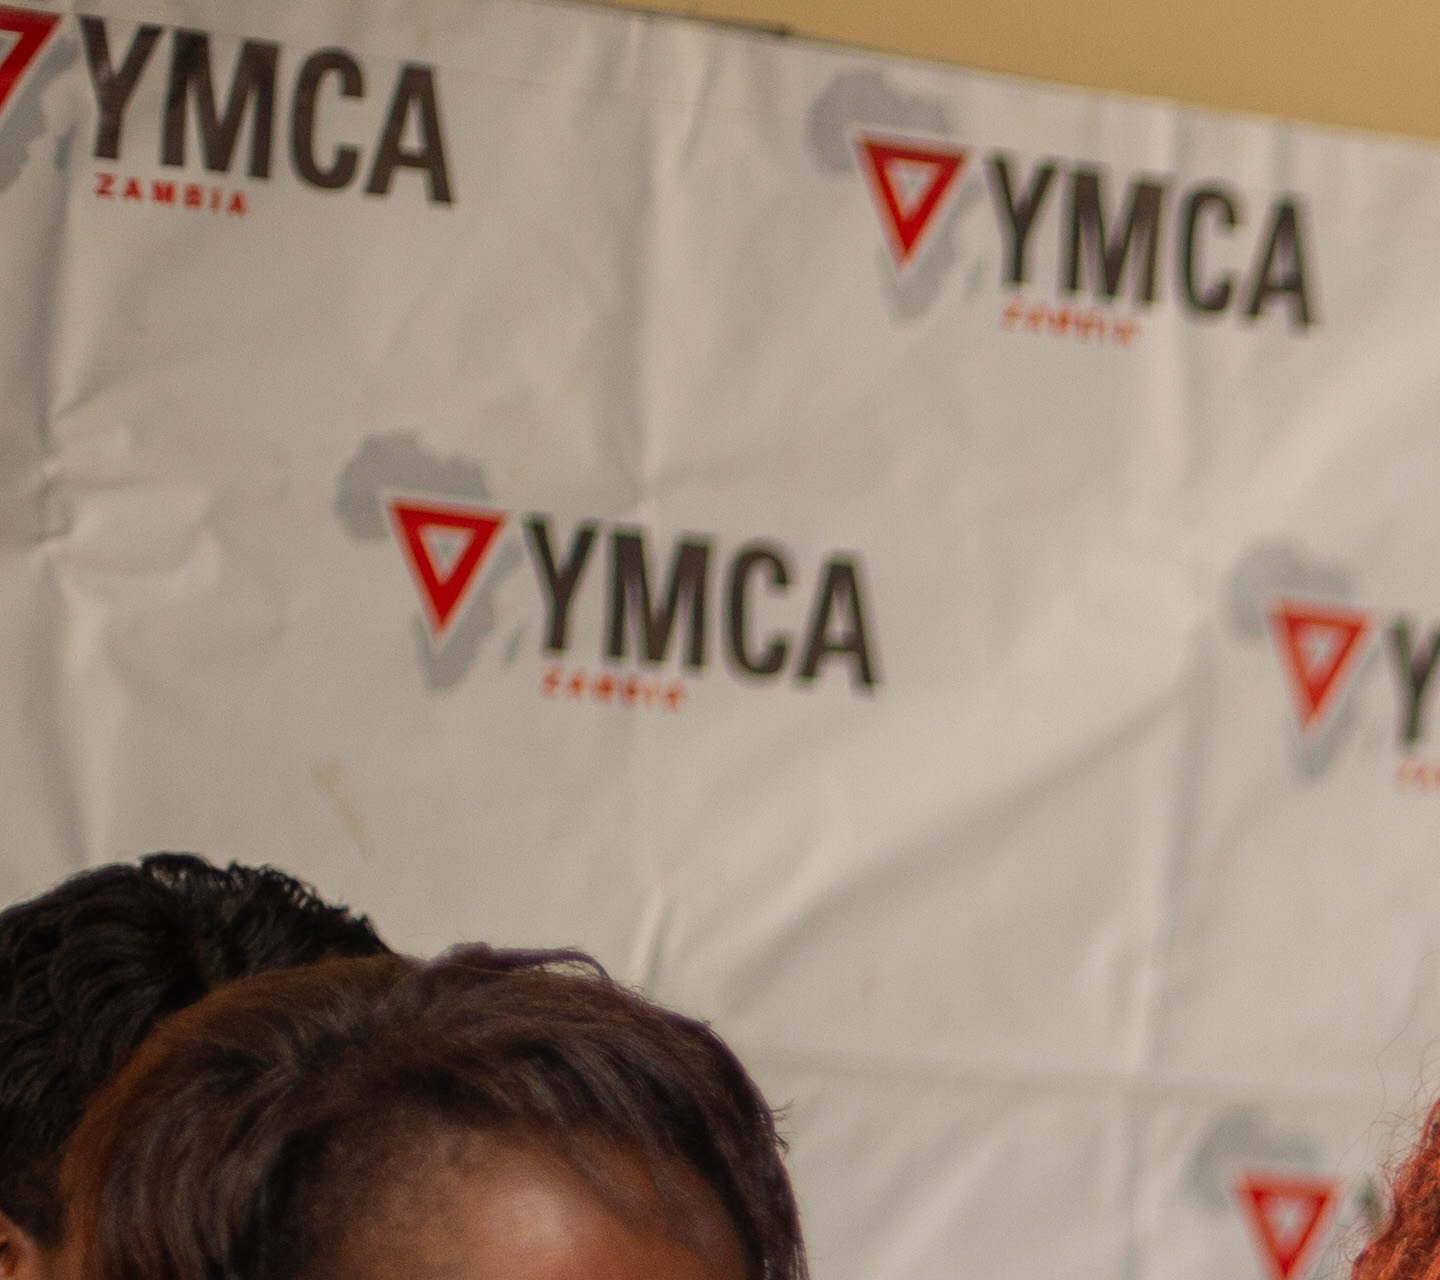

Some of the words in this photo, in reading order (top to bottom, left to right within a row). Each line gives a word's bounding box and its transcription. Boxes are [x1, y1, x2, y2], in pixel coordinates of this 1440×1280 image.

[80, 14, 456, 206] YMCA
[95, 172, 248, 216] ZAMBIA
[985, 152, 1322, 334] YMCA
[524, 512, 882, 694] YMCA
